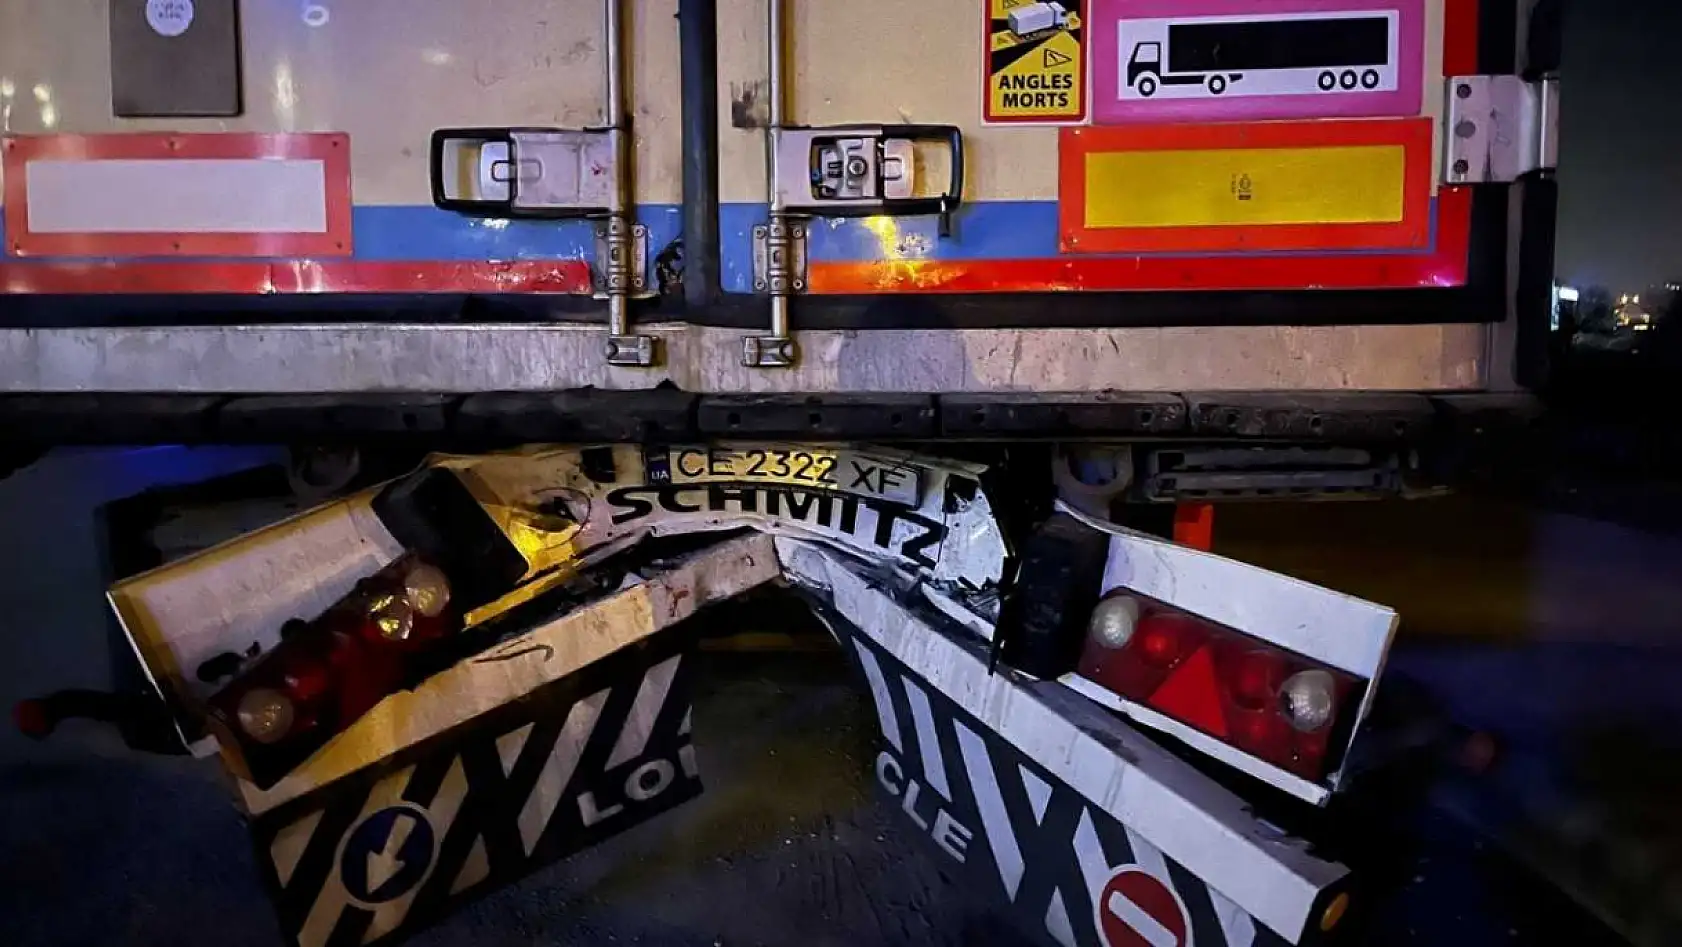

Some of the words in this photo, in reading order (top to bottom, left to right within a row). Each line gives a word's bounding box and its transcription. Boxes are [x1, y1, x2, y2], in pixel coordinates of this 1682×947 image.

[999, 74, 1073, 90] ANGLES
[1003, 93, 1069, 108] MORTS
[651, 471, 669, 480] UA
[677, 449, 736, 478] CE
[745, 449, 838, 484] 2322
[850, 460, 907, 496] XF
[606, 484, 950, 568] SCHMITZ
[875, 750, 974, 864] CLE
